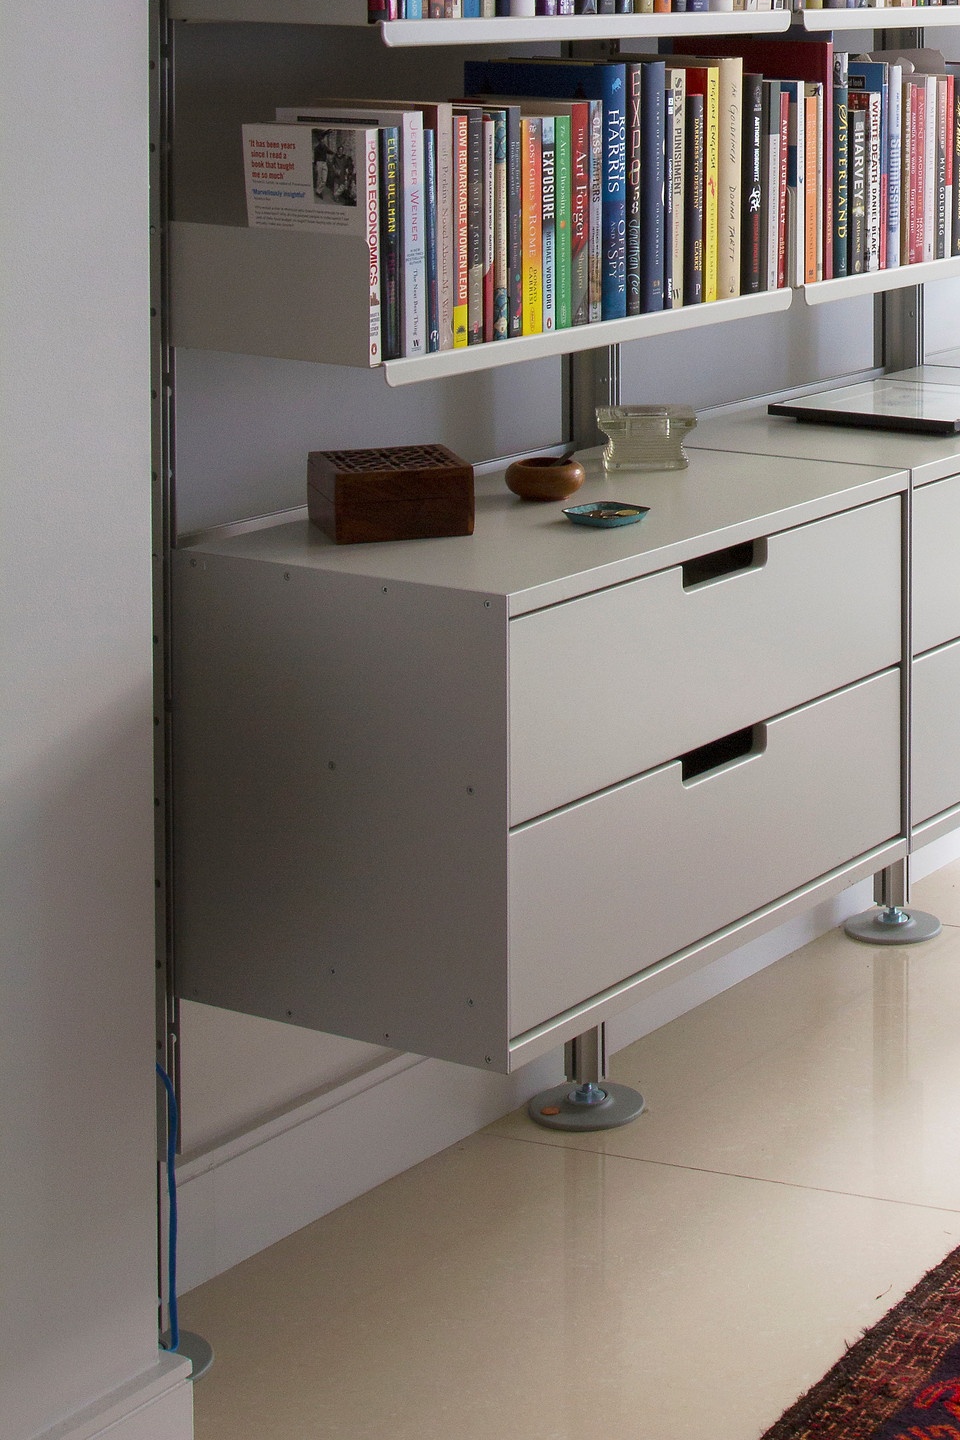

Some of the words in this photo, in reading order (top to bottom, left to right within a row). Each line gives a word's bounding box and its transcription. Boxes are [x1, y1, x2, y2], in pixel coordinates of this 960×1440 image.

[368, 141, 377, 186] POOR
[410, 121, 419, 185] JENNIFER
[608, 110, 617, 192] HARRIS
[855, 133, 864, 199] HARVEY
[459, 151, 467, 223] REMARKABLE
[543, 151, 554, 219] EXPOSURE
[369, 189, 378, 286] ECONOMICS
[411, 190, 420, 242] WEINER
[459, 226, 467, 268] WOMEN
[609, 250, 617, 279] SPY
[628, 219, 640, 269] Jonathan
[459, 271, 467, 299] LEAD
[628, 273, 640, 295] Coe
